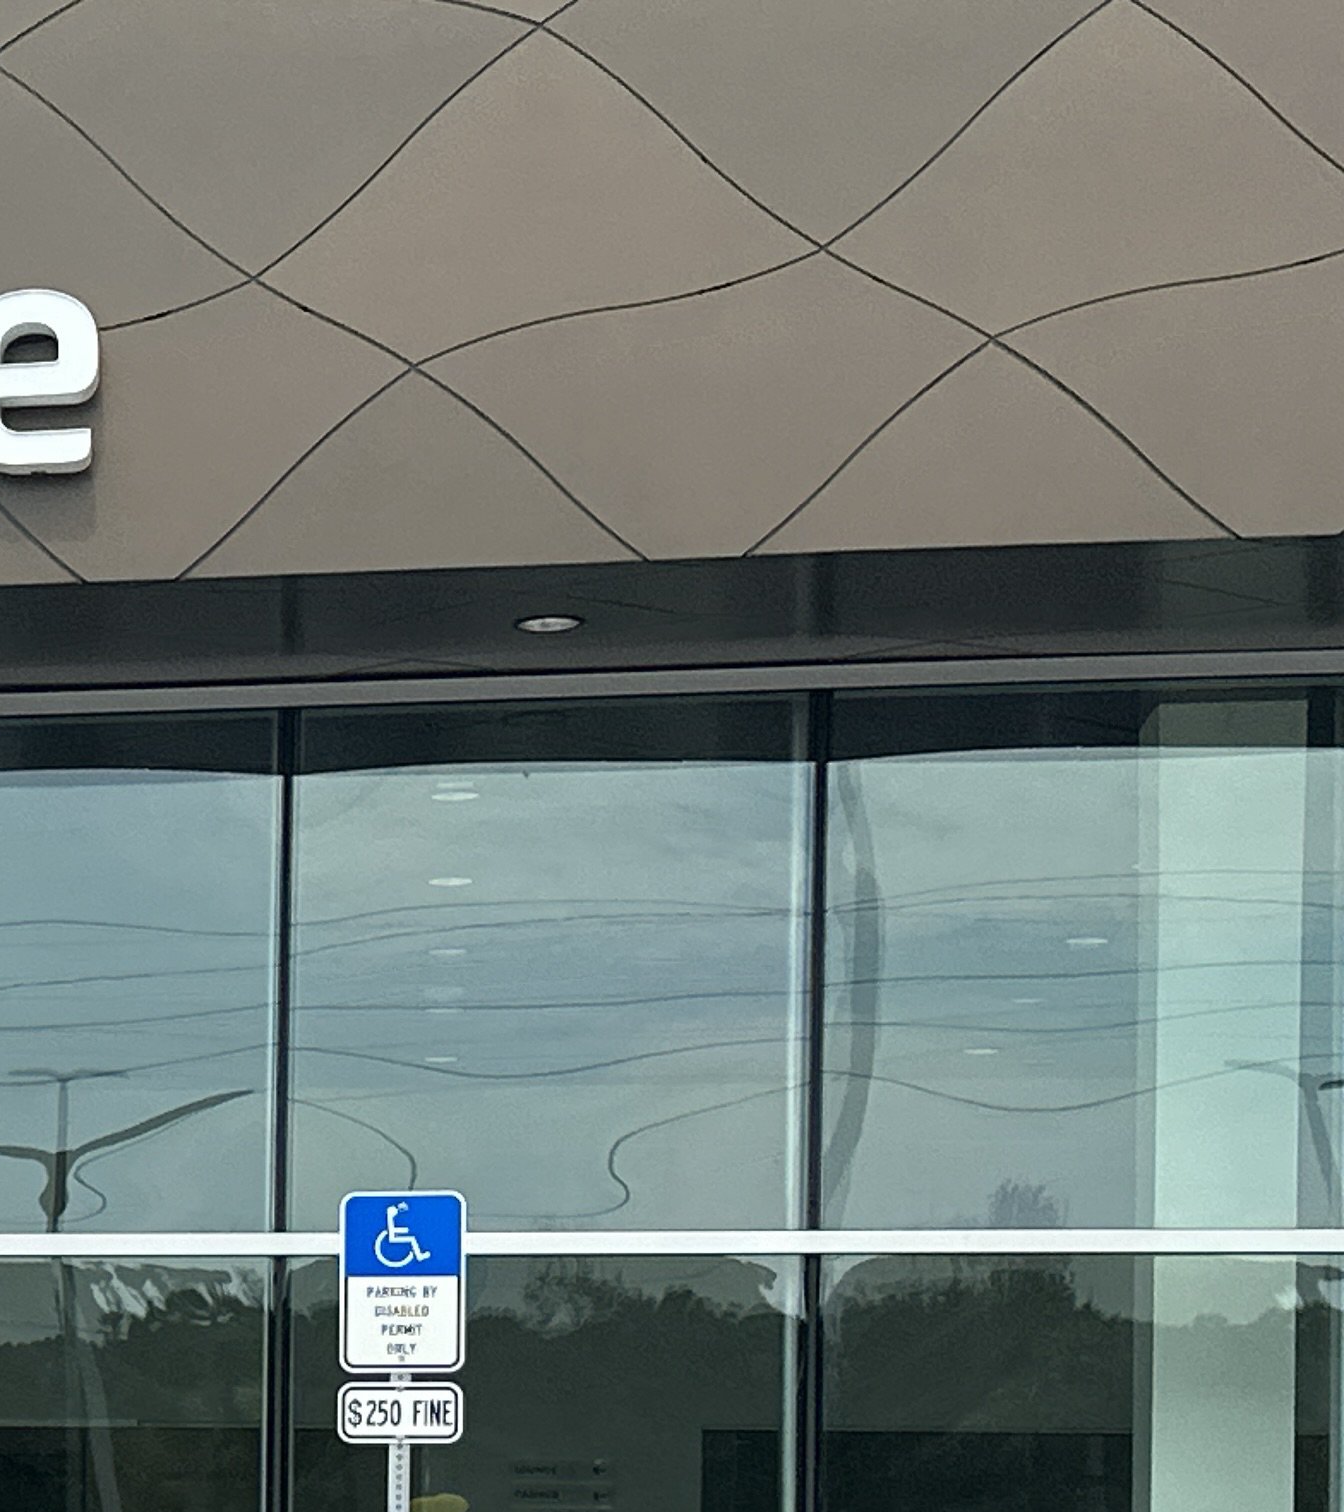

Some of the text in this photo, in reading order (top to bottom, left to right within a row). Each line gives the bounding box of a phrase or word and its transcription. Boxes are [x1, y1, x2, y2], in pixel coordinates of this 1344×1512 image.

[366, 1285, 438, 1298] PARKING BY
[374, 1304, 429, 1317] DISABLED
[381, 1323, 423, 1336] PERMIT
[347, 1398, 454, 1428] $250 FINE
